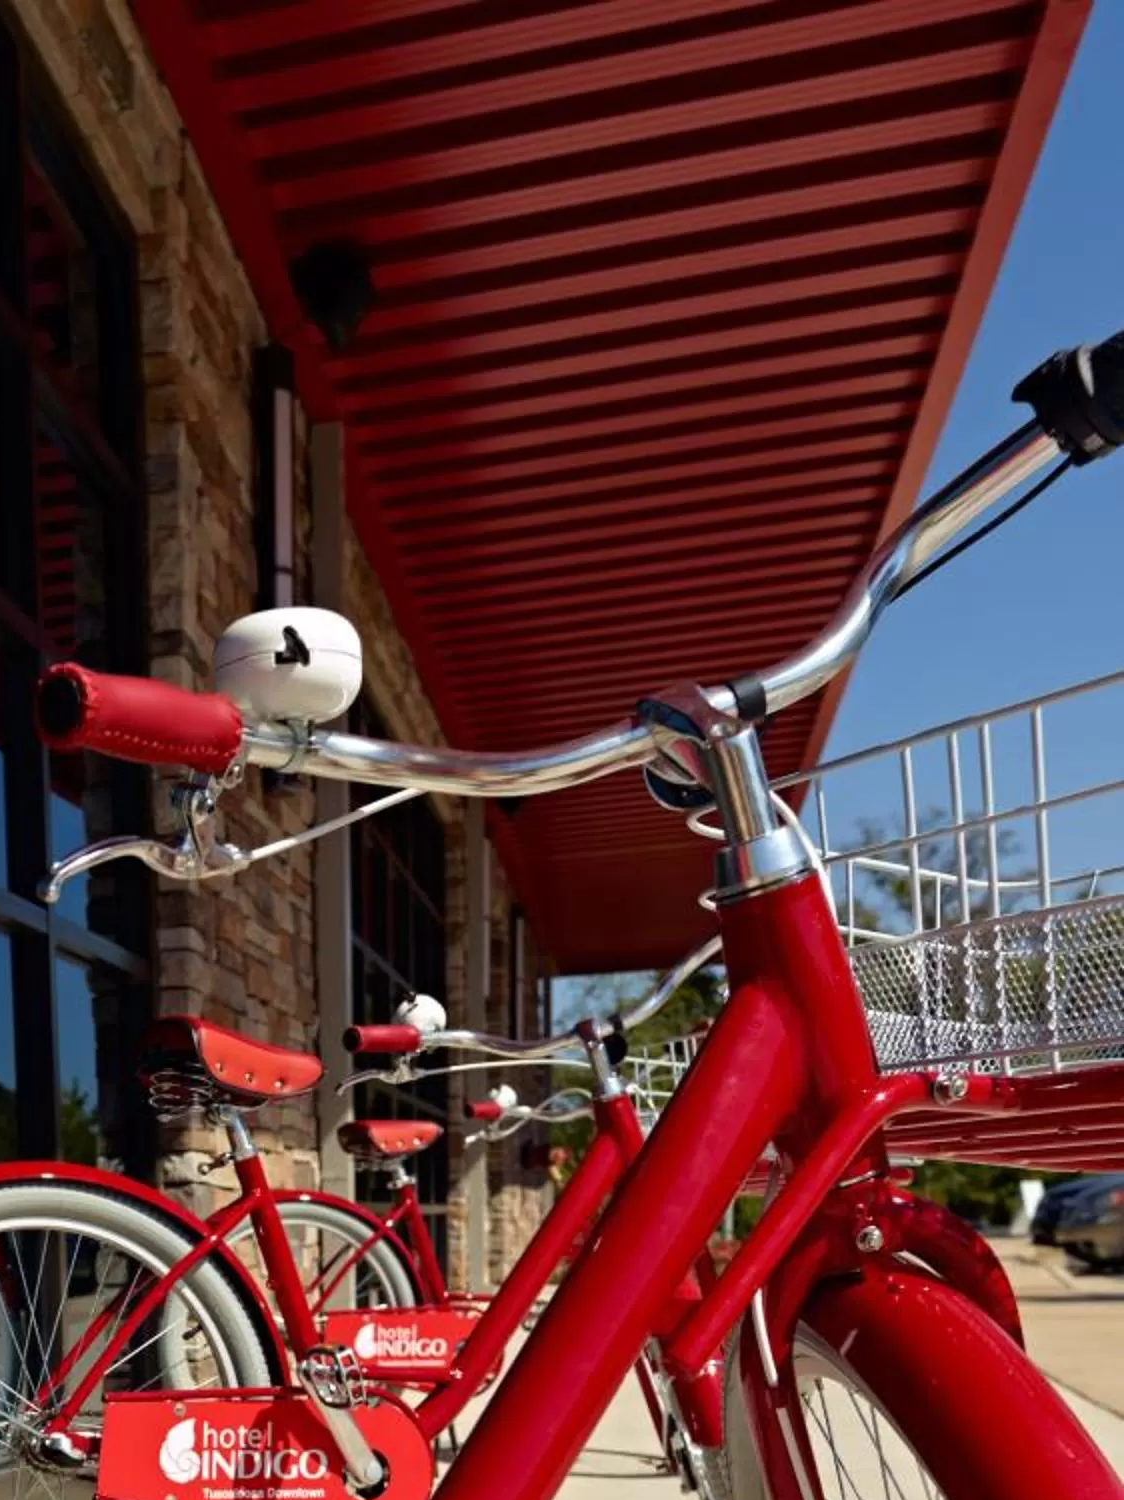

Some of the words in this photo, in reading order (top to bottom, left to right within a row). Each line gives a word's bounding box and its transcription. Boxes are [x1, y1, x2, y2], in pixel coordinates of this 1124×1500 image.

[377, 1323, 417, 1340] hotel
[377, 1337, 448, 1357] INDIGO
[202, 1421, 273, 1448] hotel
[201, 1449, 328, 1480] INDIGO
